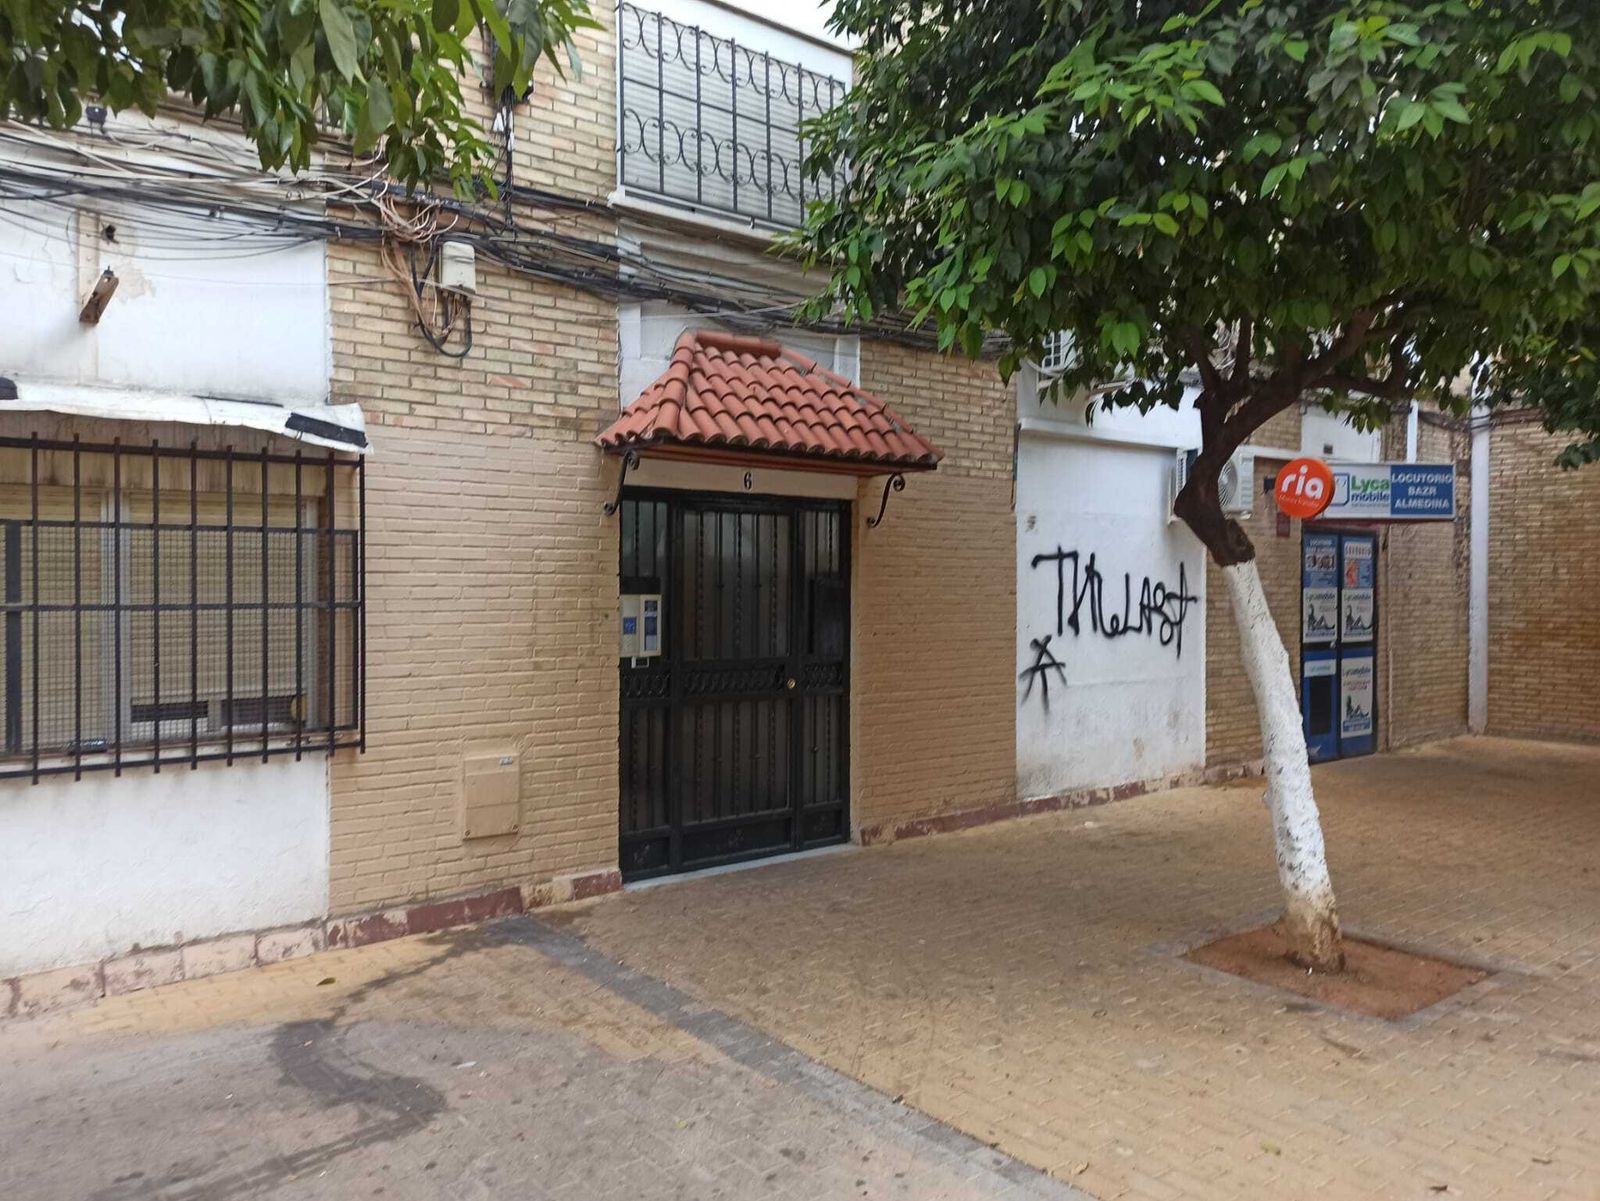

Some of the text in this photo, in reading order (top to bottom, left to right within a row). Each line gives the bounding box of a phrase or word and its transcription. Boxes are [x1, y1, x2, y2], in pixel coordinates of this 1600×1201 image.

[744, 471, 752, 490] 6
[1281, 464, 1324, 500] ria
[1351, 475, 1390, 492] Lyca
[1391, 473, 1452, 484] LOCUTORIO
[1351, 491, 1390, 502] mobile
[1394, 499, 1450, 509] ALMEDINA
